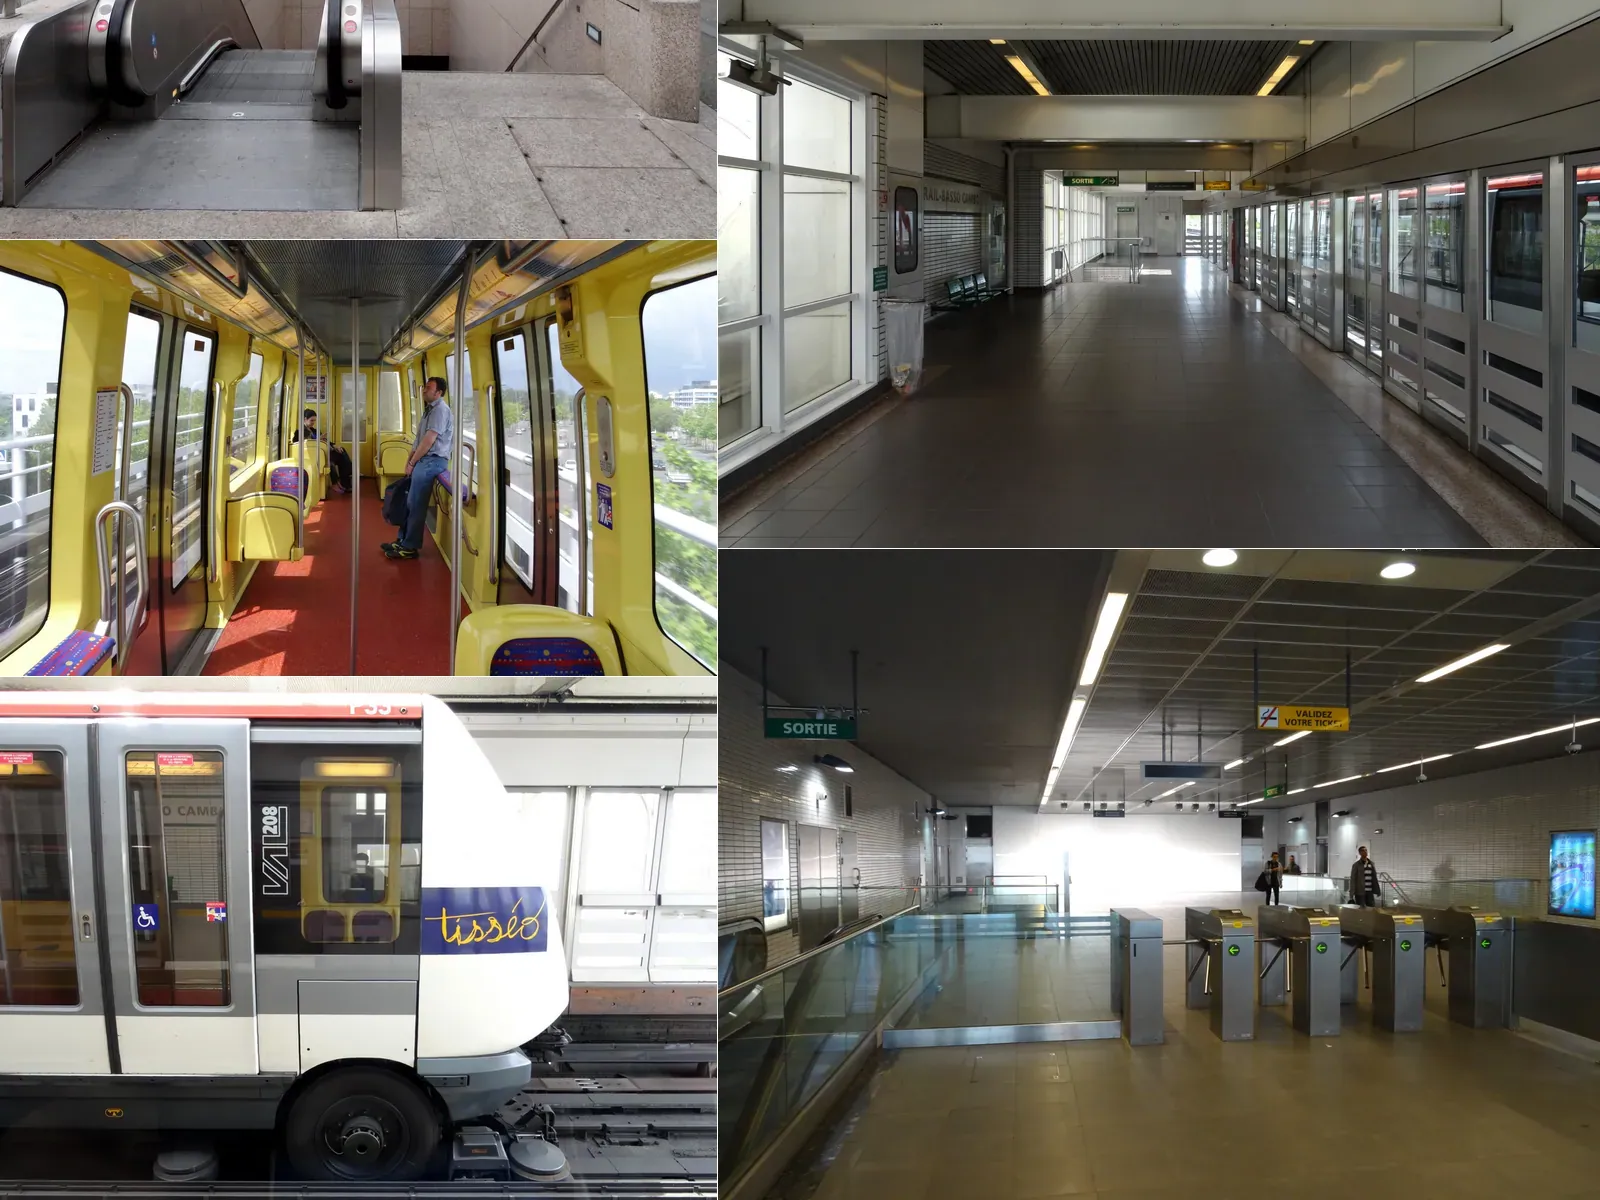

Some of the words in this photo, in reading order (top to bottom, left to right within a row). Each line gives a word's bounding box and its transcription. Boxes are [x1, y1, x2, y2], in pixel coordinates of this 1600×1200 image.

[1295, 710, 1333, 718] VALIDEZ
[782, 722, 838, 735] SORTIE
[1284, 718, 1313, 727] VOTRE
[177, 805, 224, 817] CAMB
[262, 806, 278, 834] 208
[424, 896, 546, 946] tisséo
